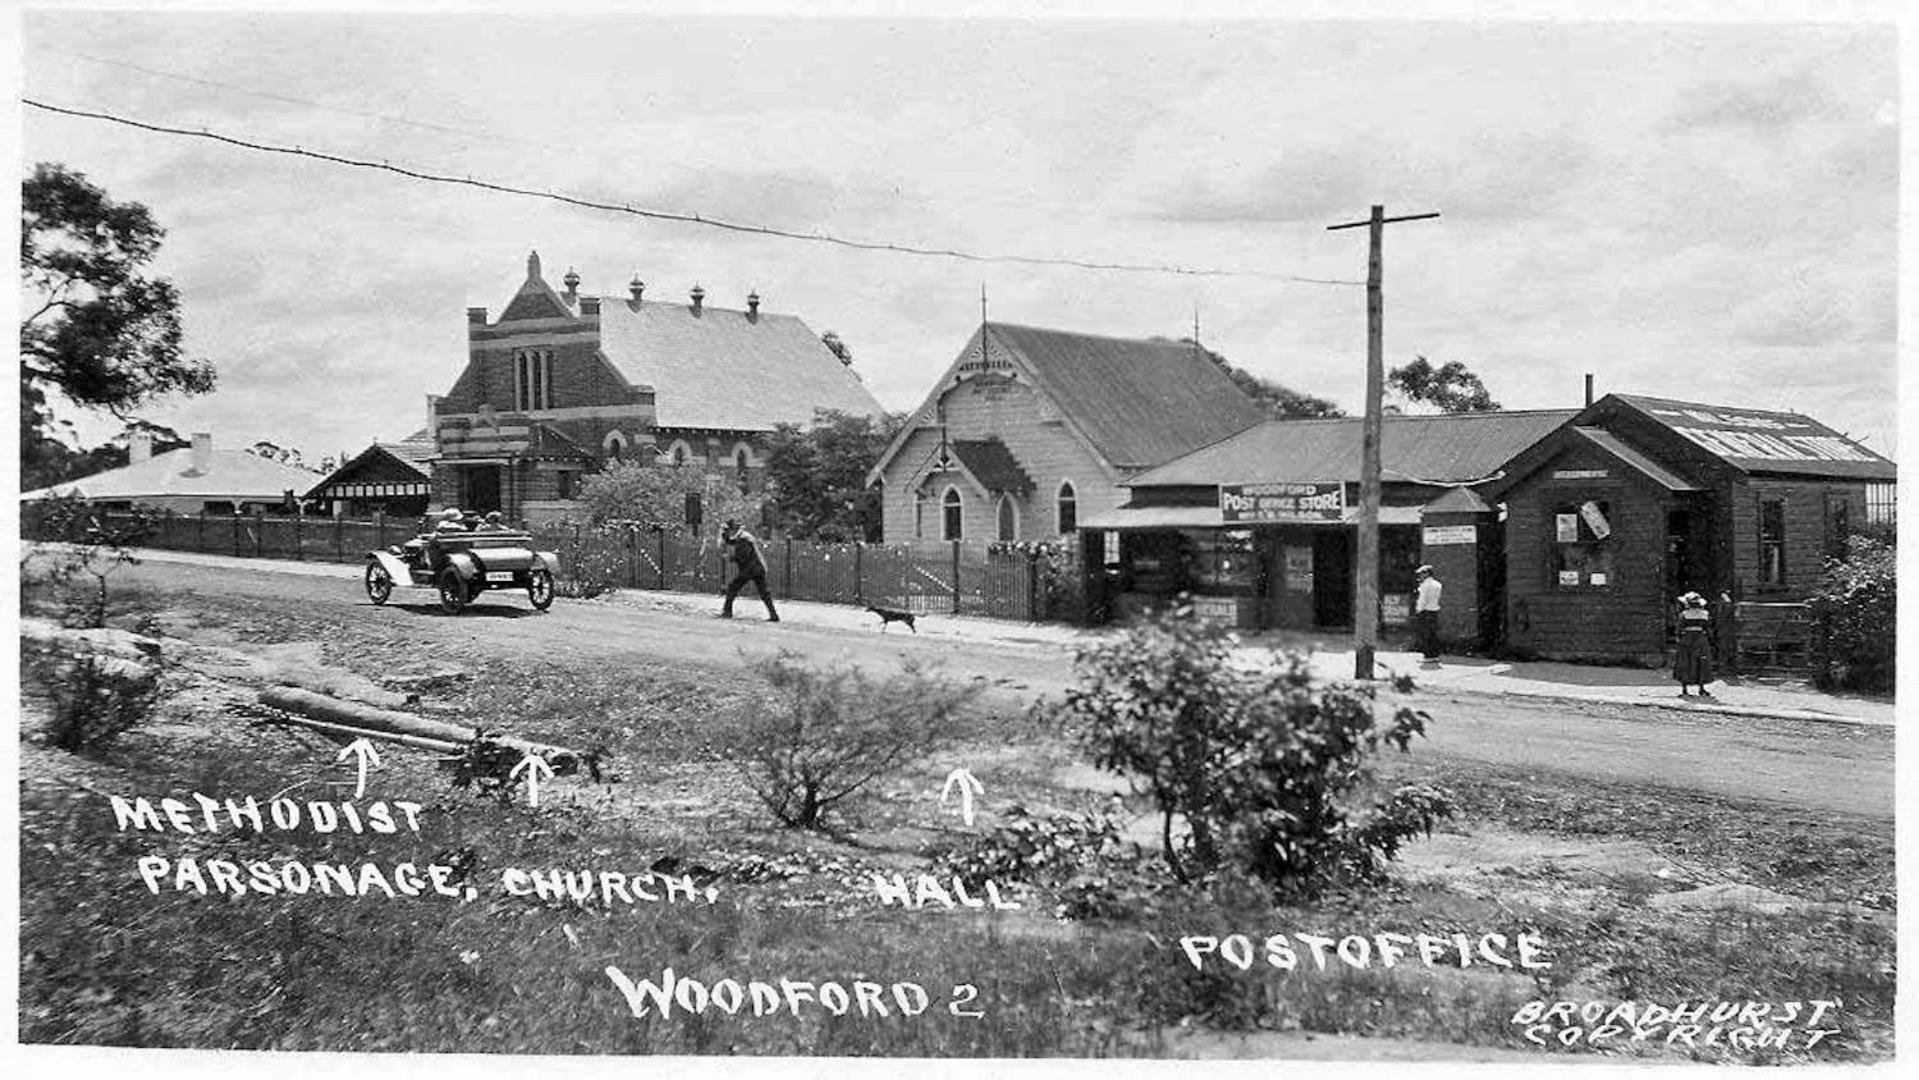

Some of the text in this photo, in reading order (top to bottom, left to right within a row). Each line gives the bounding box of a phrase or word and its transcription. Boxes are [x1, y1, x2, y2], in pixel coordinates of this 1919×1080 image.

[1242, 484, 1318, 496] WOODFORD
[1223, 490, 1341, 510] POST OFFICE STORE
